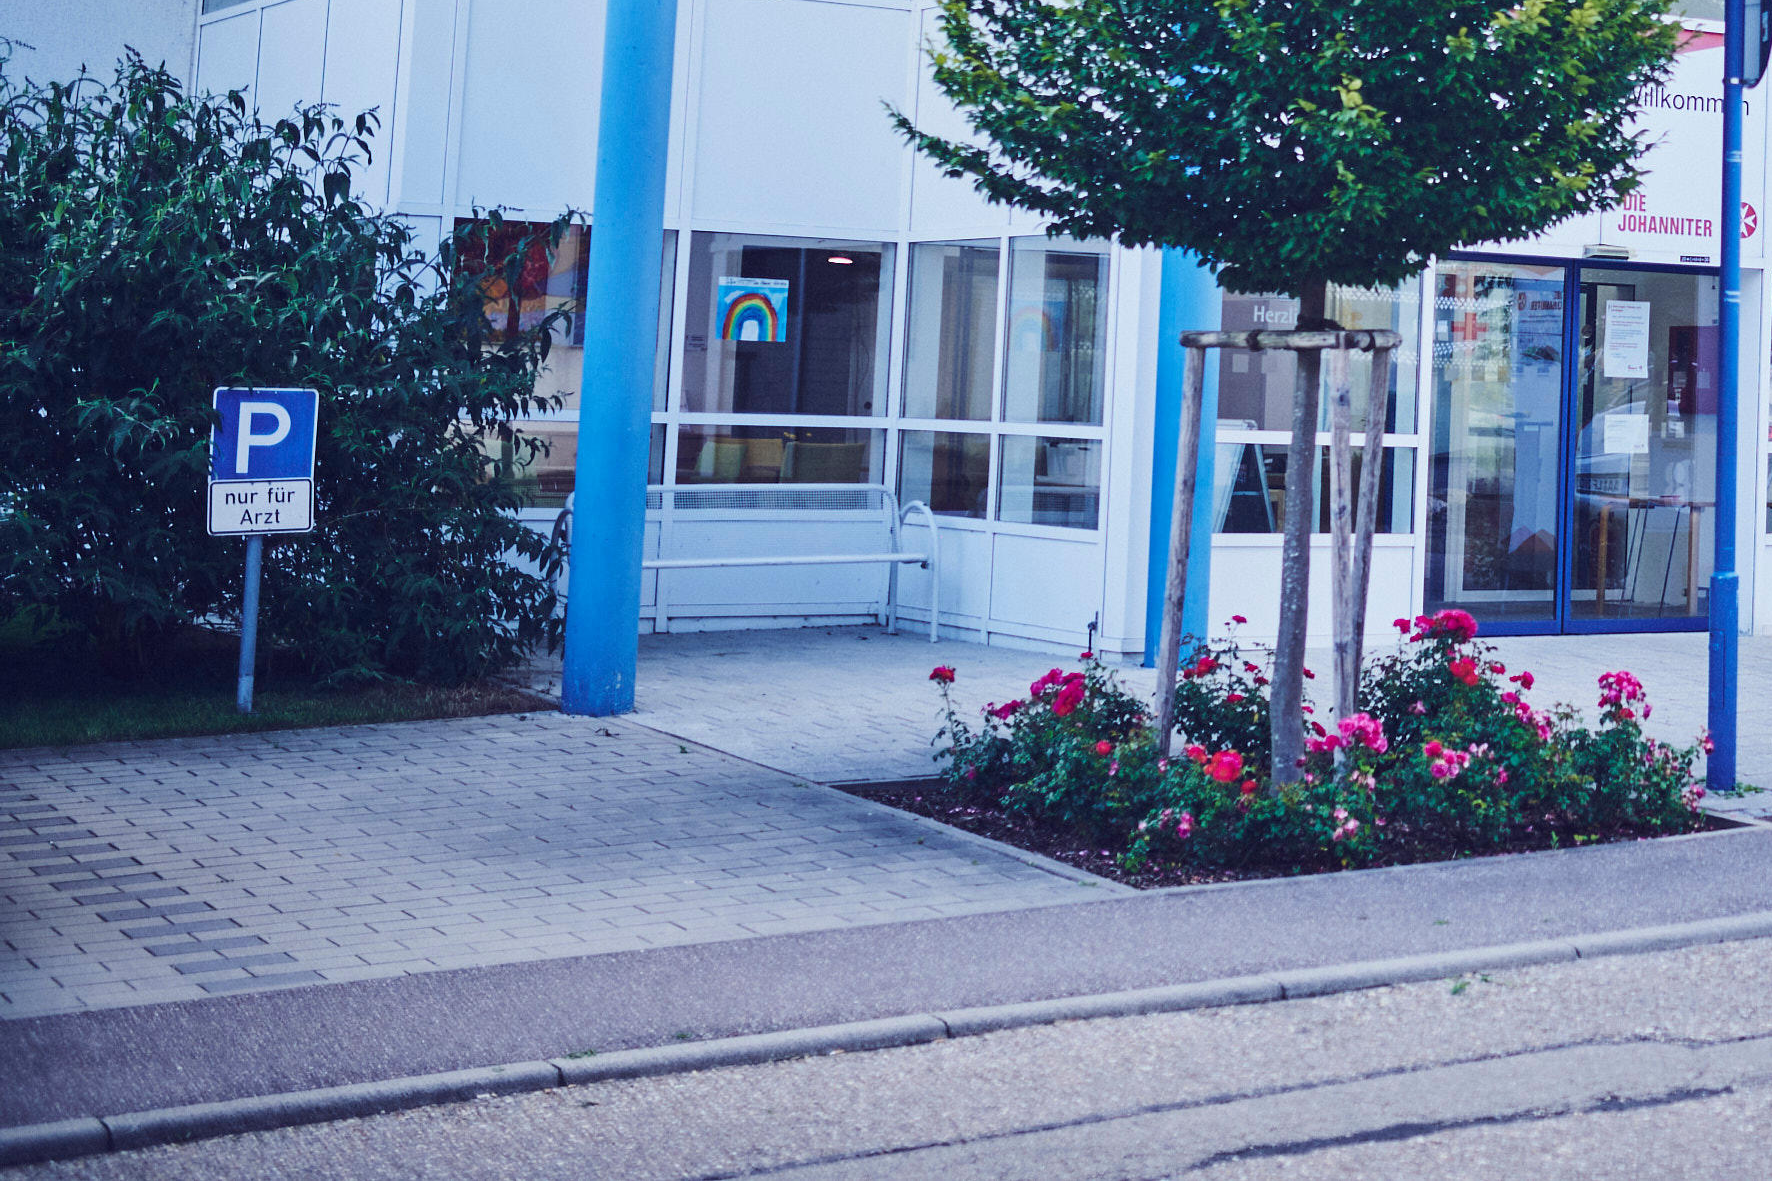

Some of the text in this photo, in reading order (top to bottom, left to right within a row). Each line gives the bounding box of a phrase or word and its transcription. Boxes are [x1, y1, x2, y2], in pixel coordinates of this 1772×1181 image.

[1623, 194, 1646, 212] DIE
[1617, 213, 1712, 237] JOHANNITER
[1253, 305, 1298, 324] Herzli
[236, 401, 292, 474] P
[225, 486, 296, 505] nur für
[239, 508, 281, 525] Arzt
